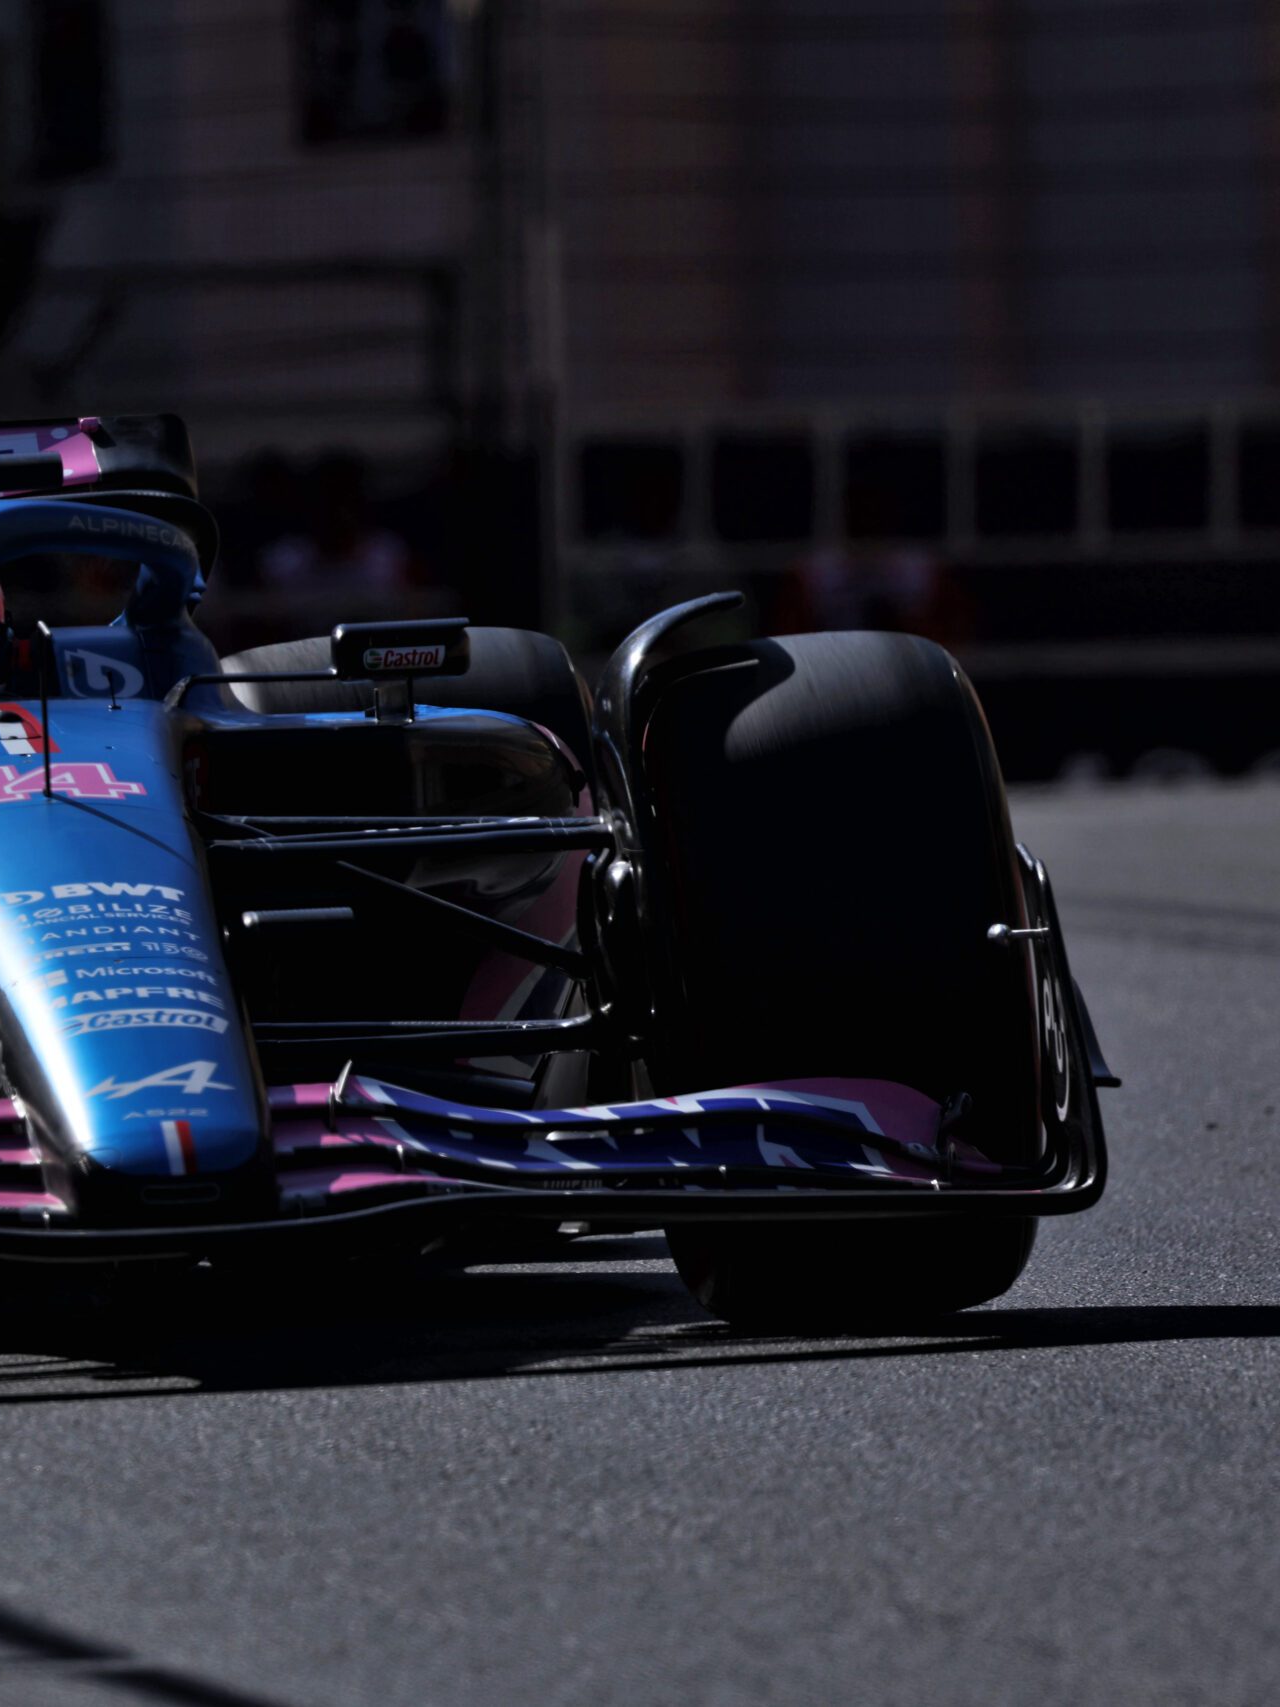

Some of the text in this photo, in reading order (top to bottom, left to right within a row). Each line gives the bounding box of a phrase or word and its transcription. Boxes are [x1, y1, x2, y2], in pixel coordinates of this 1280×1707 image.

[383, 648, 439, 668] Castrol
[50, 881, 185, 902] BWT
[75, 966, 218, 987] Microsoft
[88, 1009, 220, 1027] Castrol
